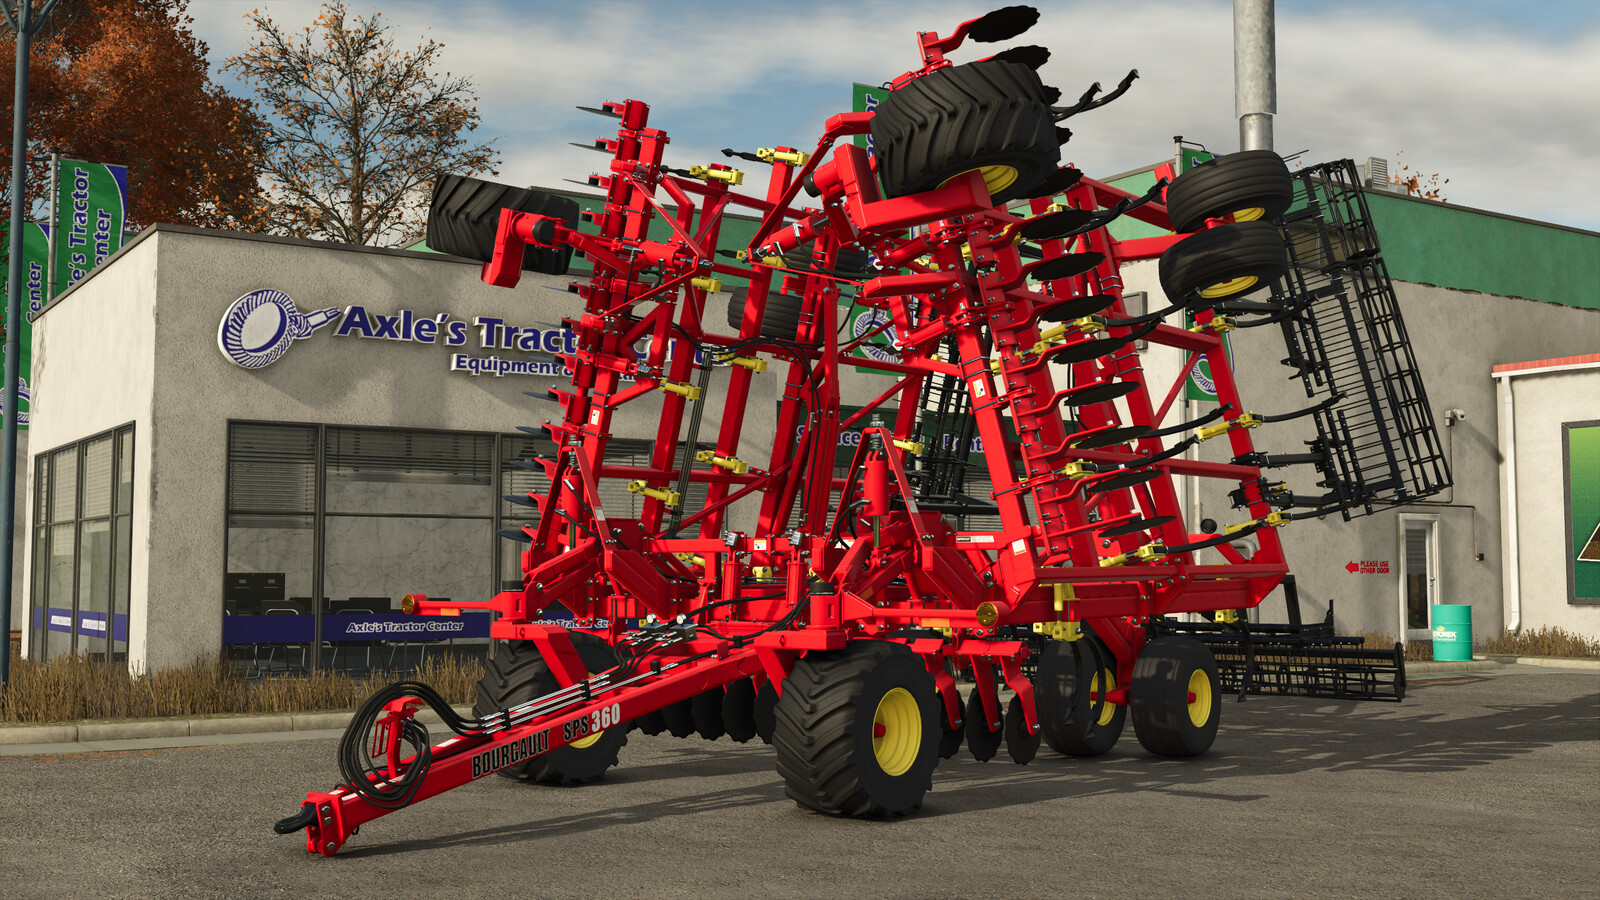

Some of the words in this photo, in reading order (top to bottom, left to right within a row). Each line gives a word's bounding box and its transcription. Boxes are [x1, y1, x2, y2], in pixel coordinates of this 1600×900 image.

[68, 167, 89, 248] Tractor
[93, 208, 112, 270] enter
[333, 305, 468, 346] Axle's
[451, 353, 559, 377] Equipment
[1360, 560, 1379, 568] PLEASE
[1379, 560, 1389, 568] USE
[346, 622, 382, 633] Axle's
[384, 621, 426, 632] Tractor
[426, 621, 464, 631] Center
[472, 728, 550, 779] BOURGAULT
[563, 715, 589, 741] SPS
[591, 703, 621, 733] 360
